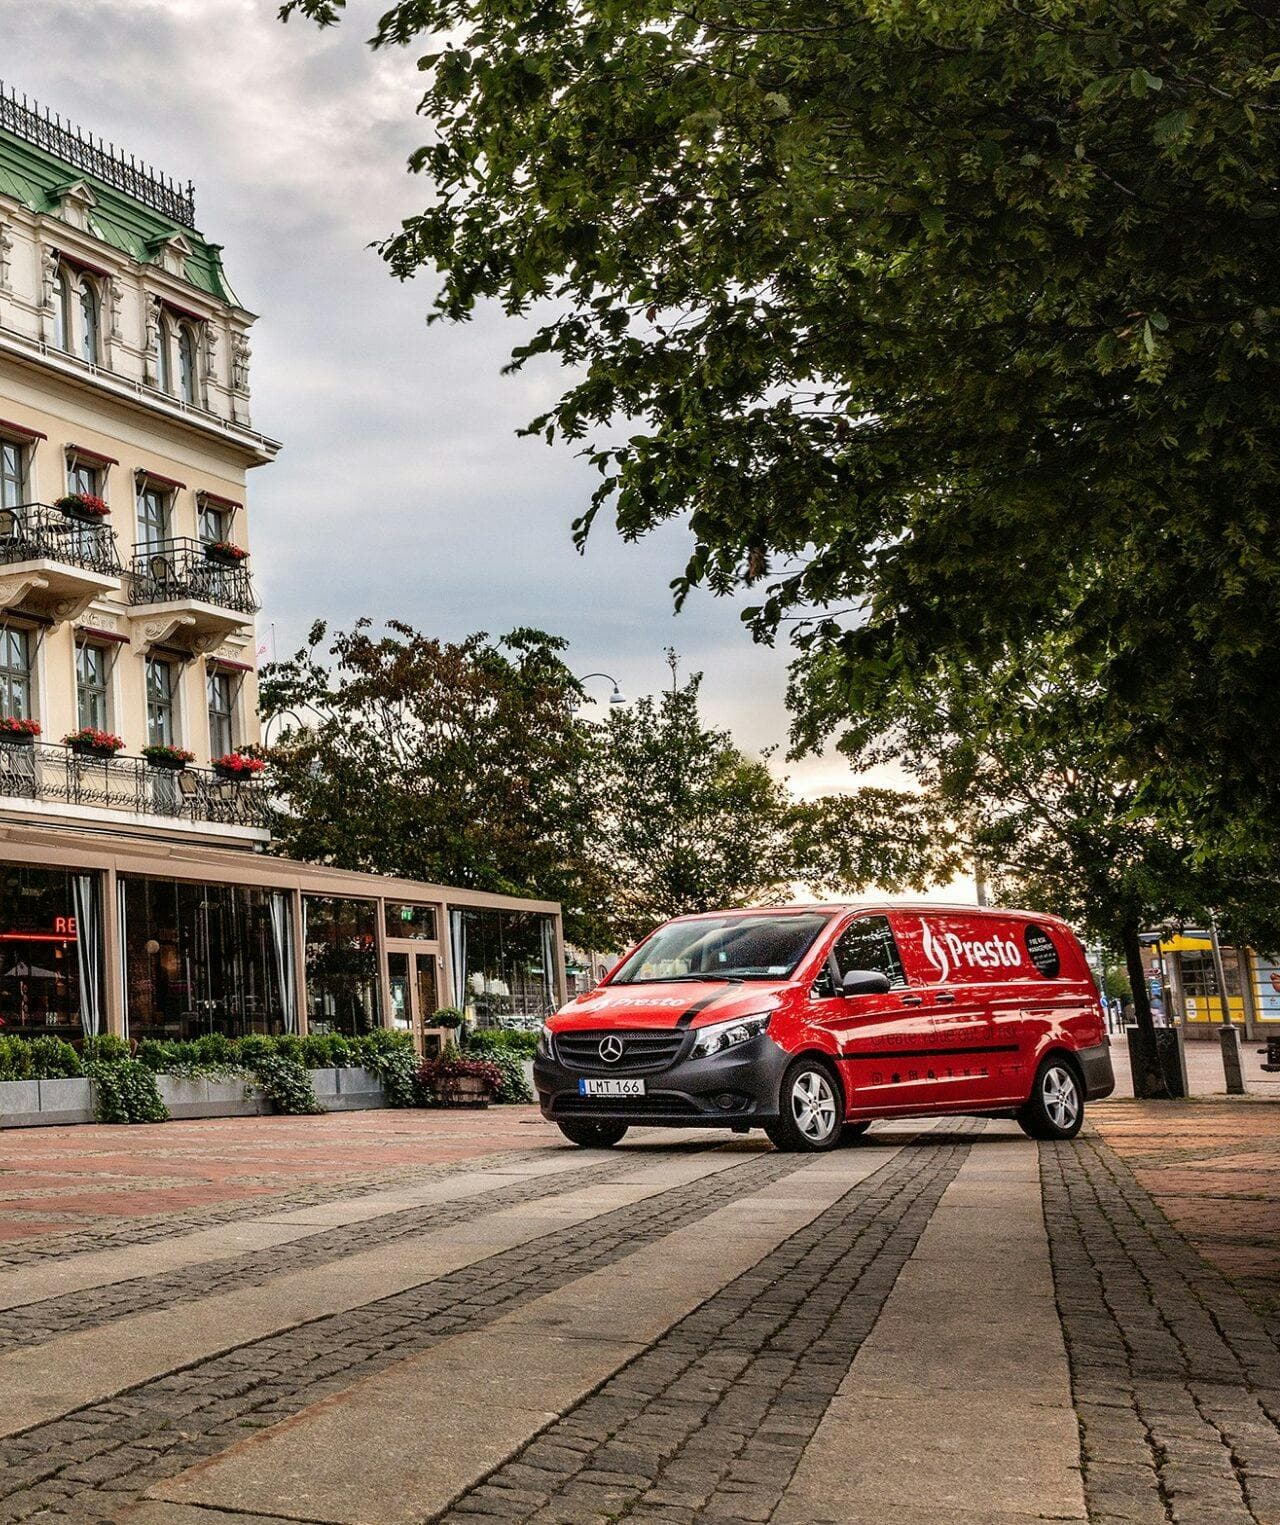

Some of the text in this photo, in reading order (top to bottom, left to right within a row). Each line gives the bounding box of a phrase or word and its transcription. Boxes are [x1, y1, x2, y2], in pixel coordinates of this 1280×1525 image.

[944, 932, 1021, 968] Presto
[588, 1080, 639, 1093] LMT 166
